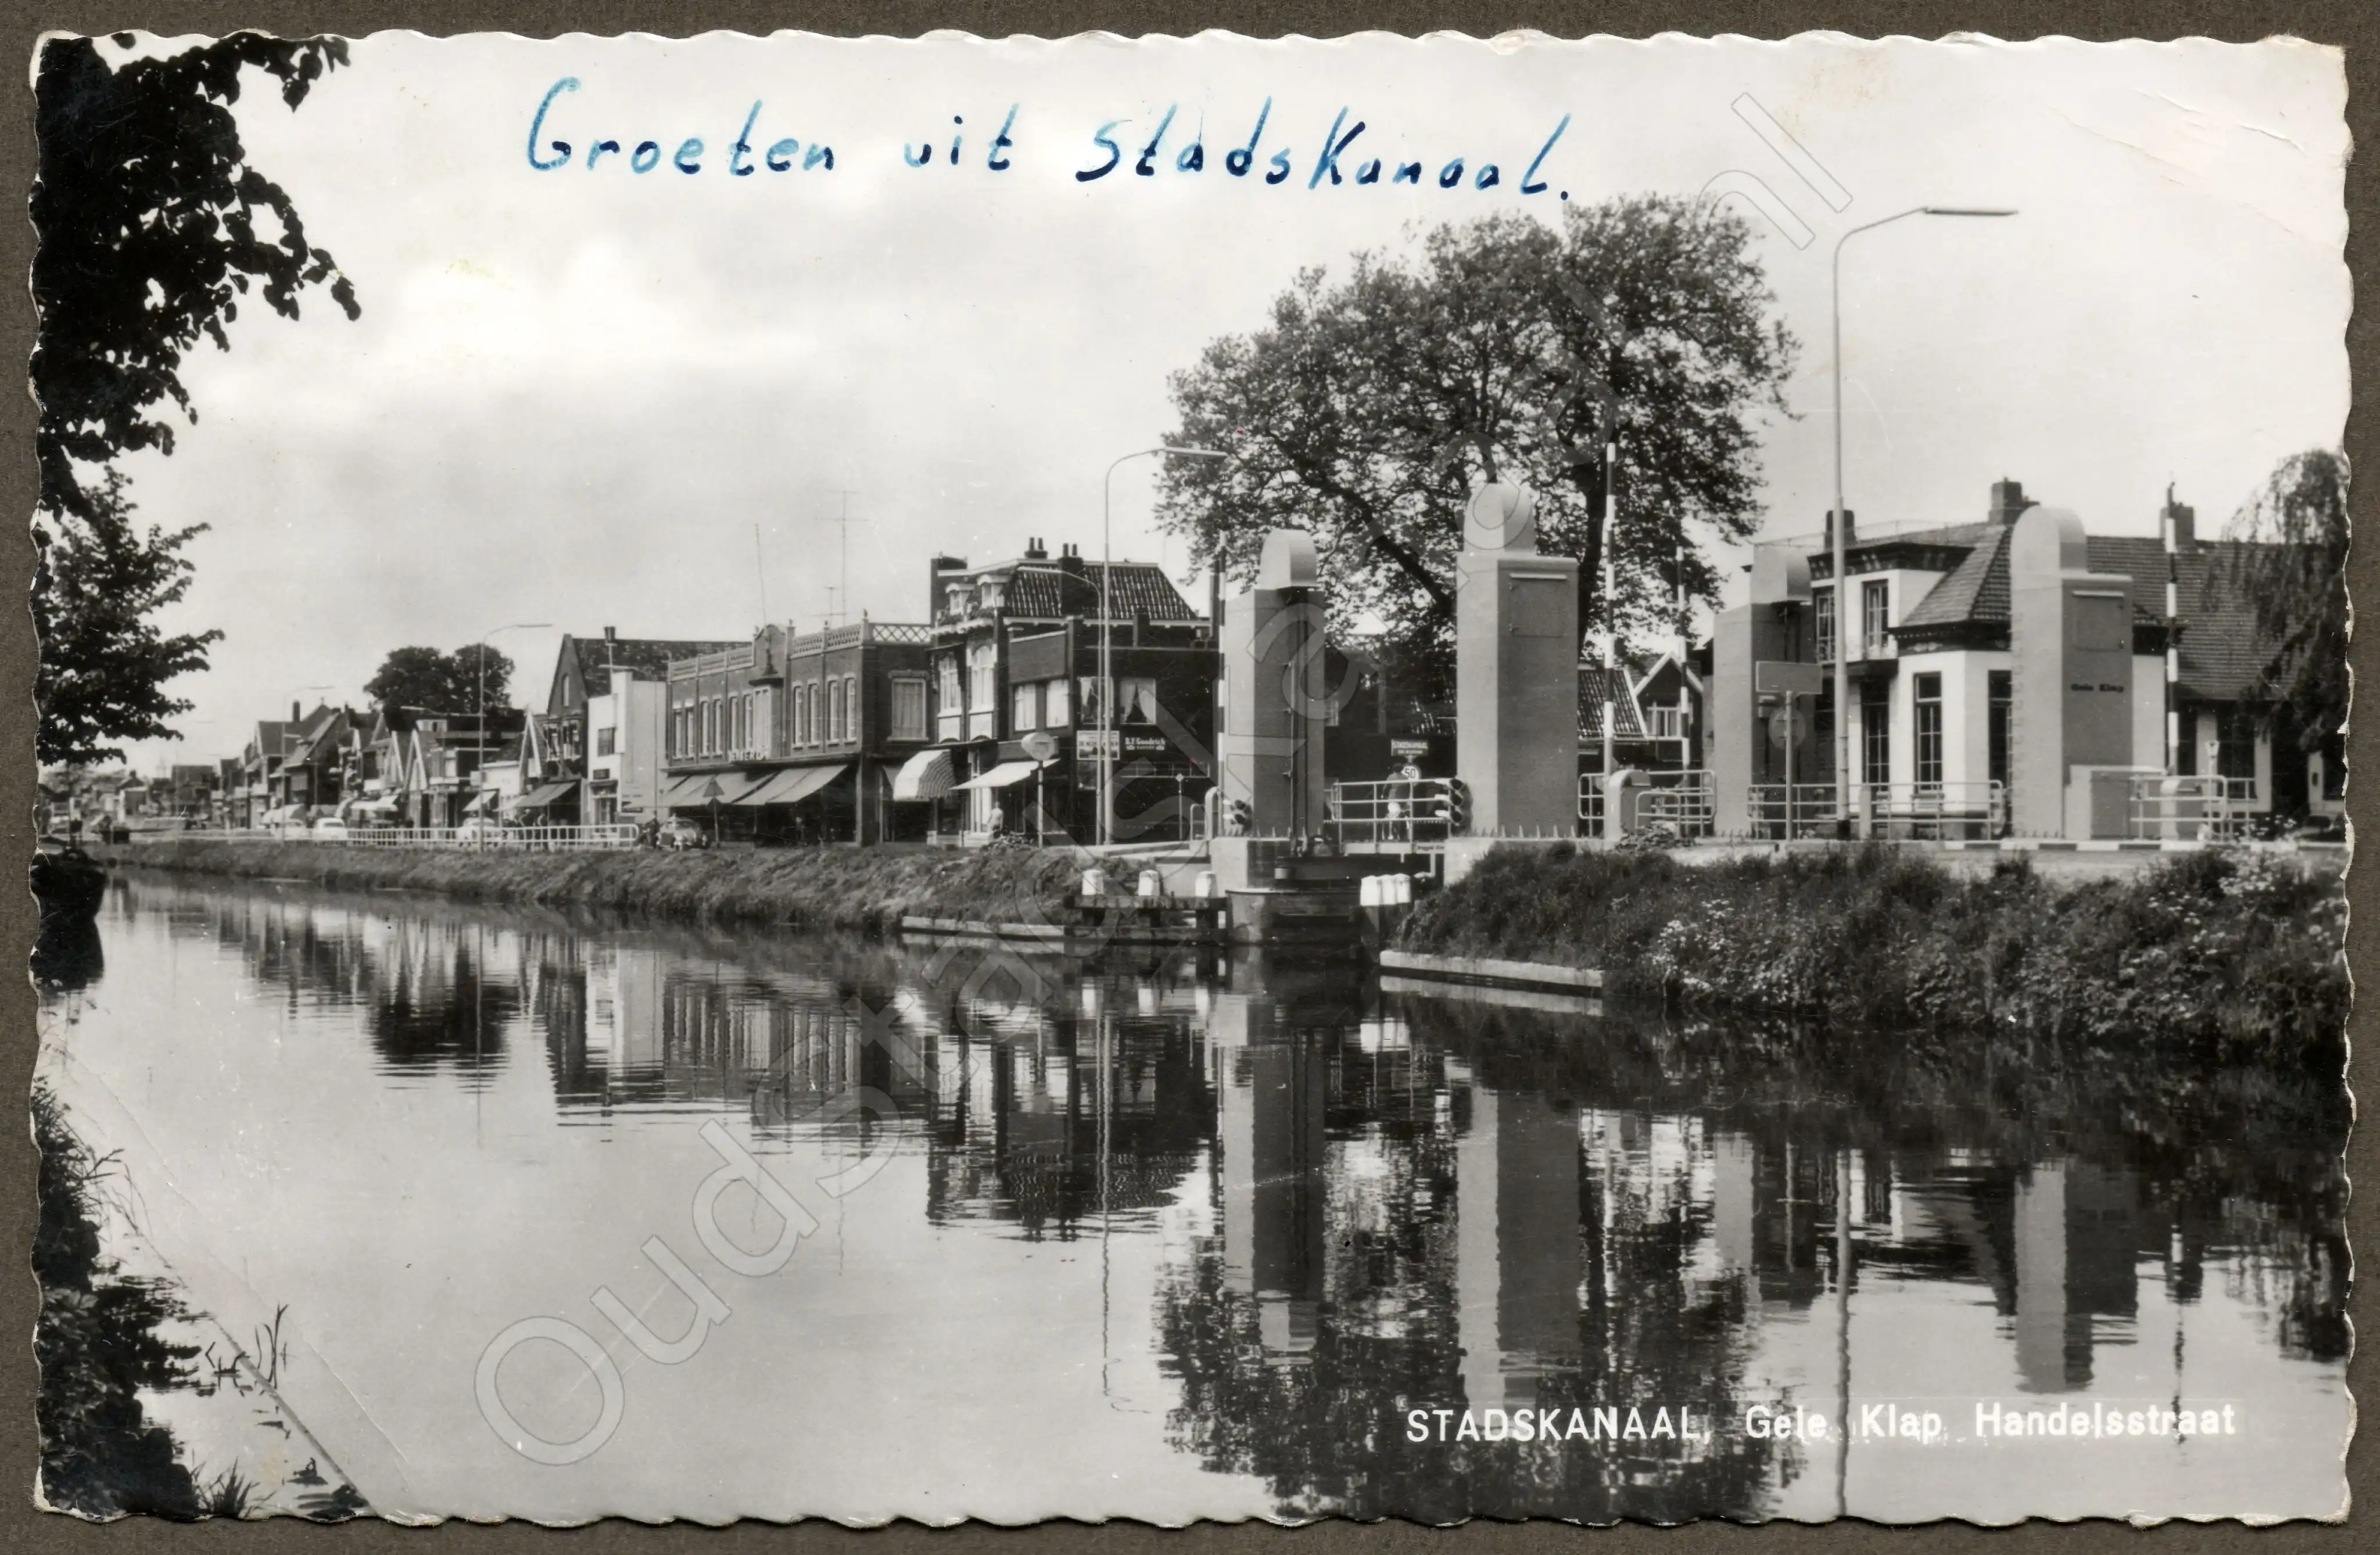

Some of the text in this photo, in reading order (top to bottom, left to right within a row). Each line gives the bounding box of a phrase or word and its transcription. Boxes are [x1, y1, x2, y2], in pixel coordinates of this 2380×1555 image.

[527, 78, 834, 177] Groeten
[904, 109, 1016, 171] uit
[1404, 767, 1416, 779] 50
